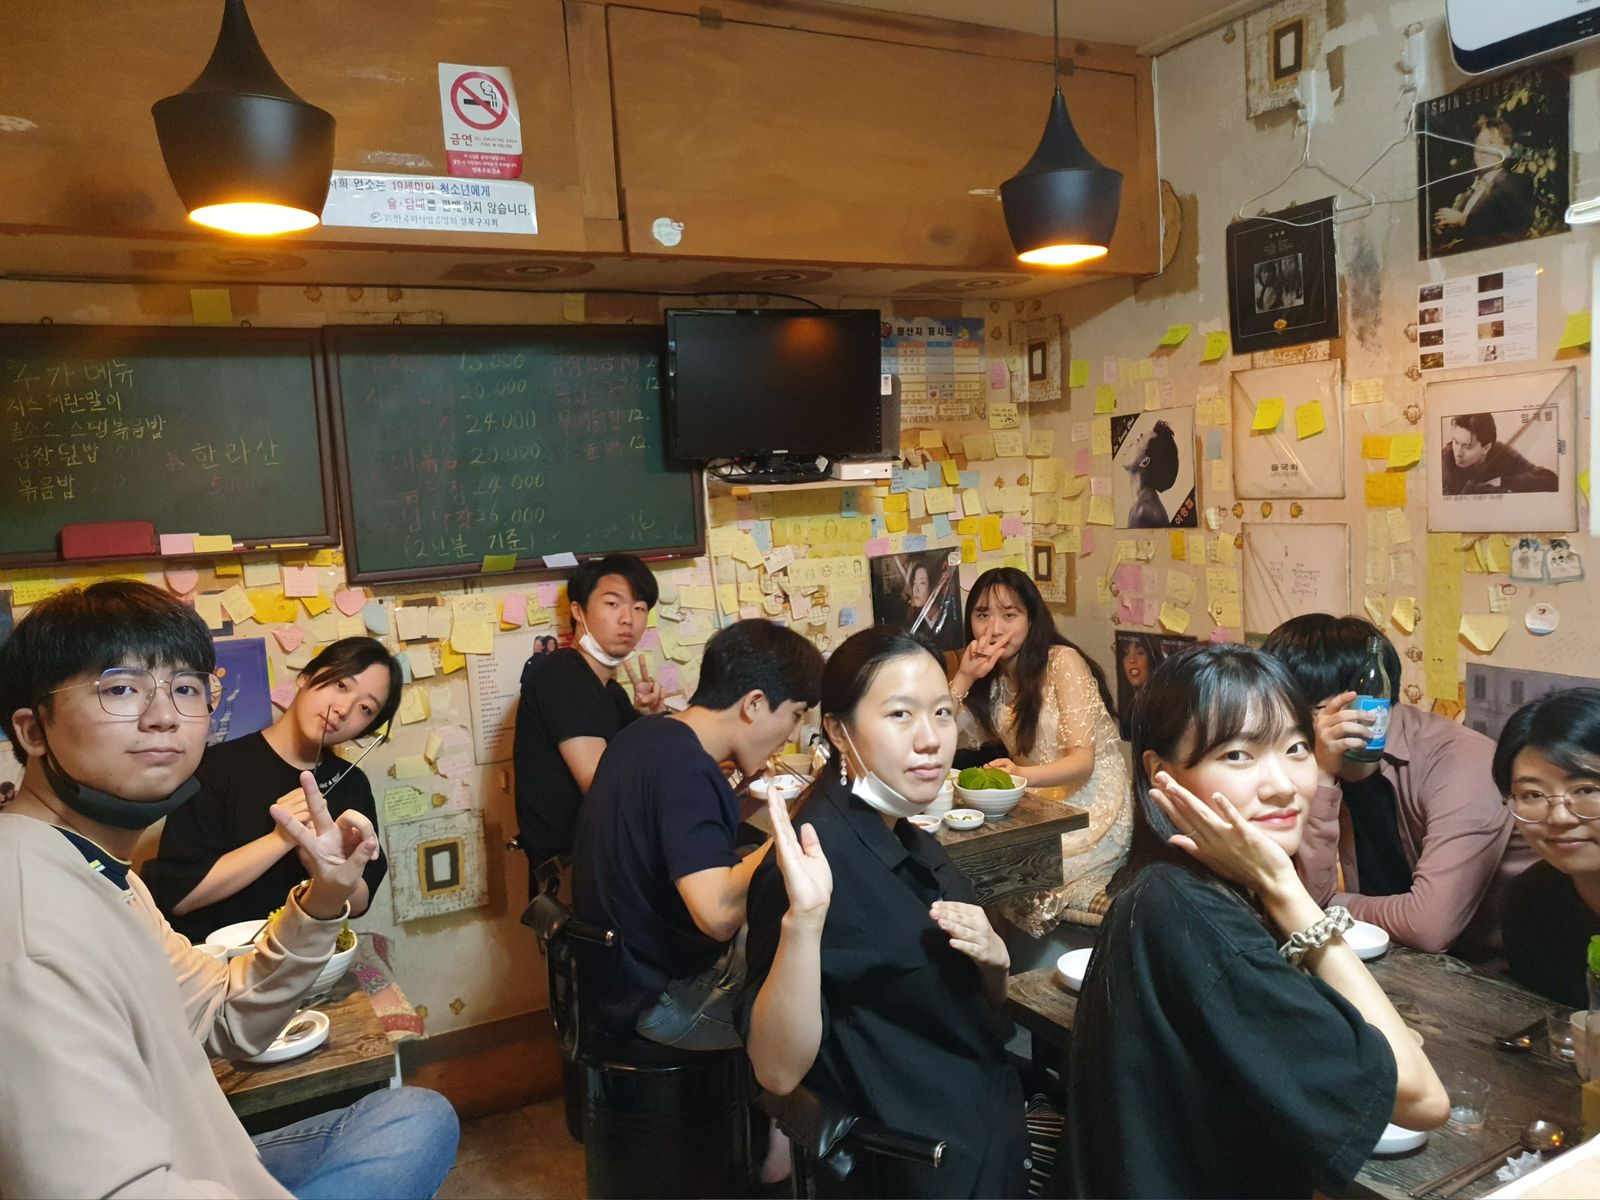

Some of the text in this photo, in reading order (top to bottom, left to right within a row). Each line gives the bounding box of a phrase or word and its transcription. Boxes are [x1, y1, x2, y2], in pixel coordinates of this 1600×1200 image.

[449, 133, 473, 147] 금연
[391, 180, 435, 195] 19세미만
[440, 182, 491, 198] 청소년에게
[487, 202, 530, 217] 않습니다.
[191, 434, 281, 470] 한라산
[18, 474, 76, 504] 볶음밥
